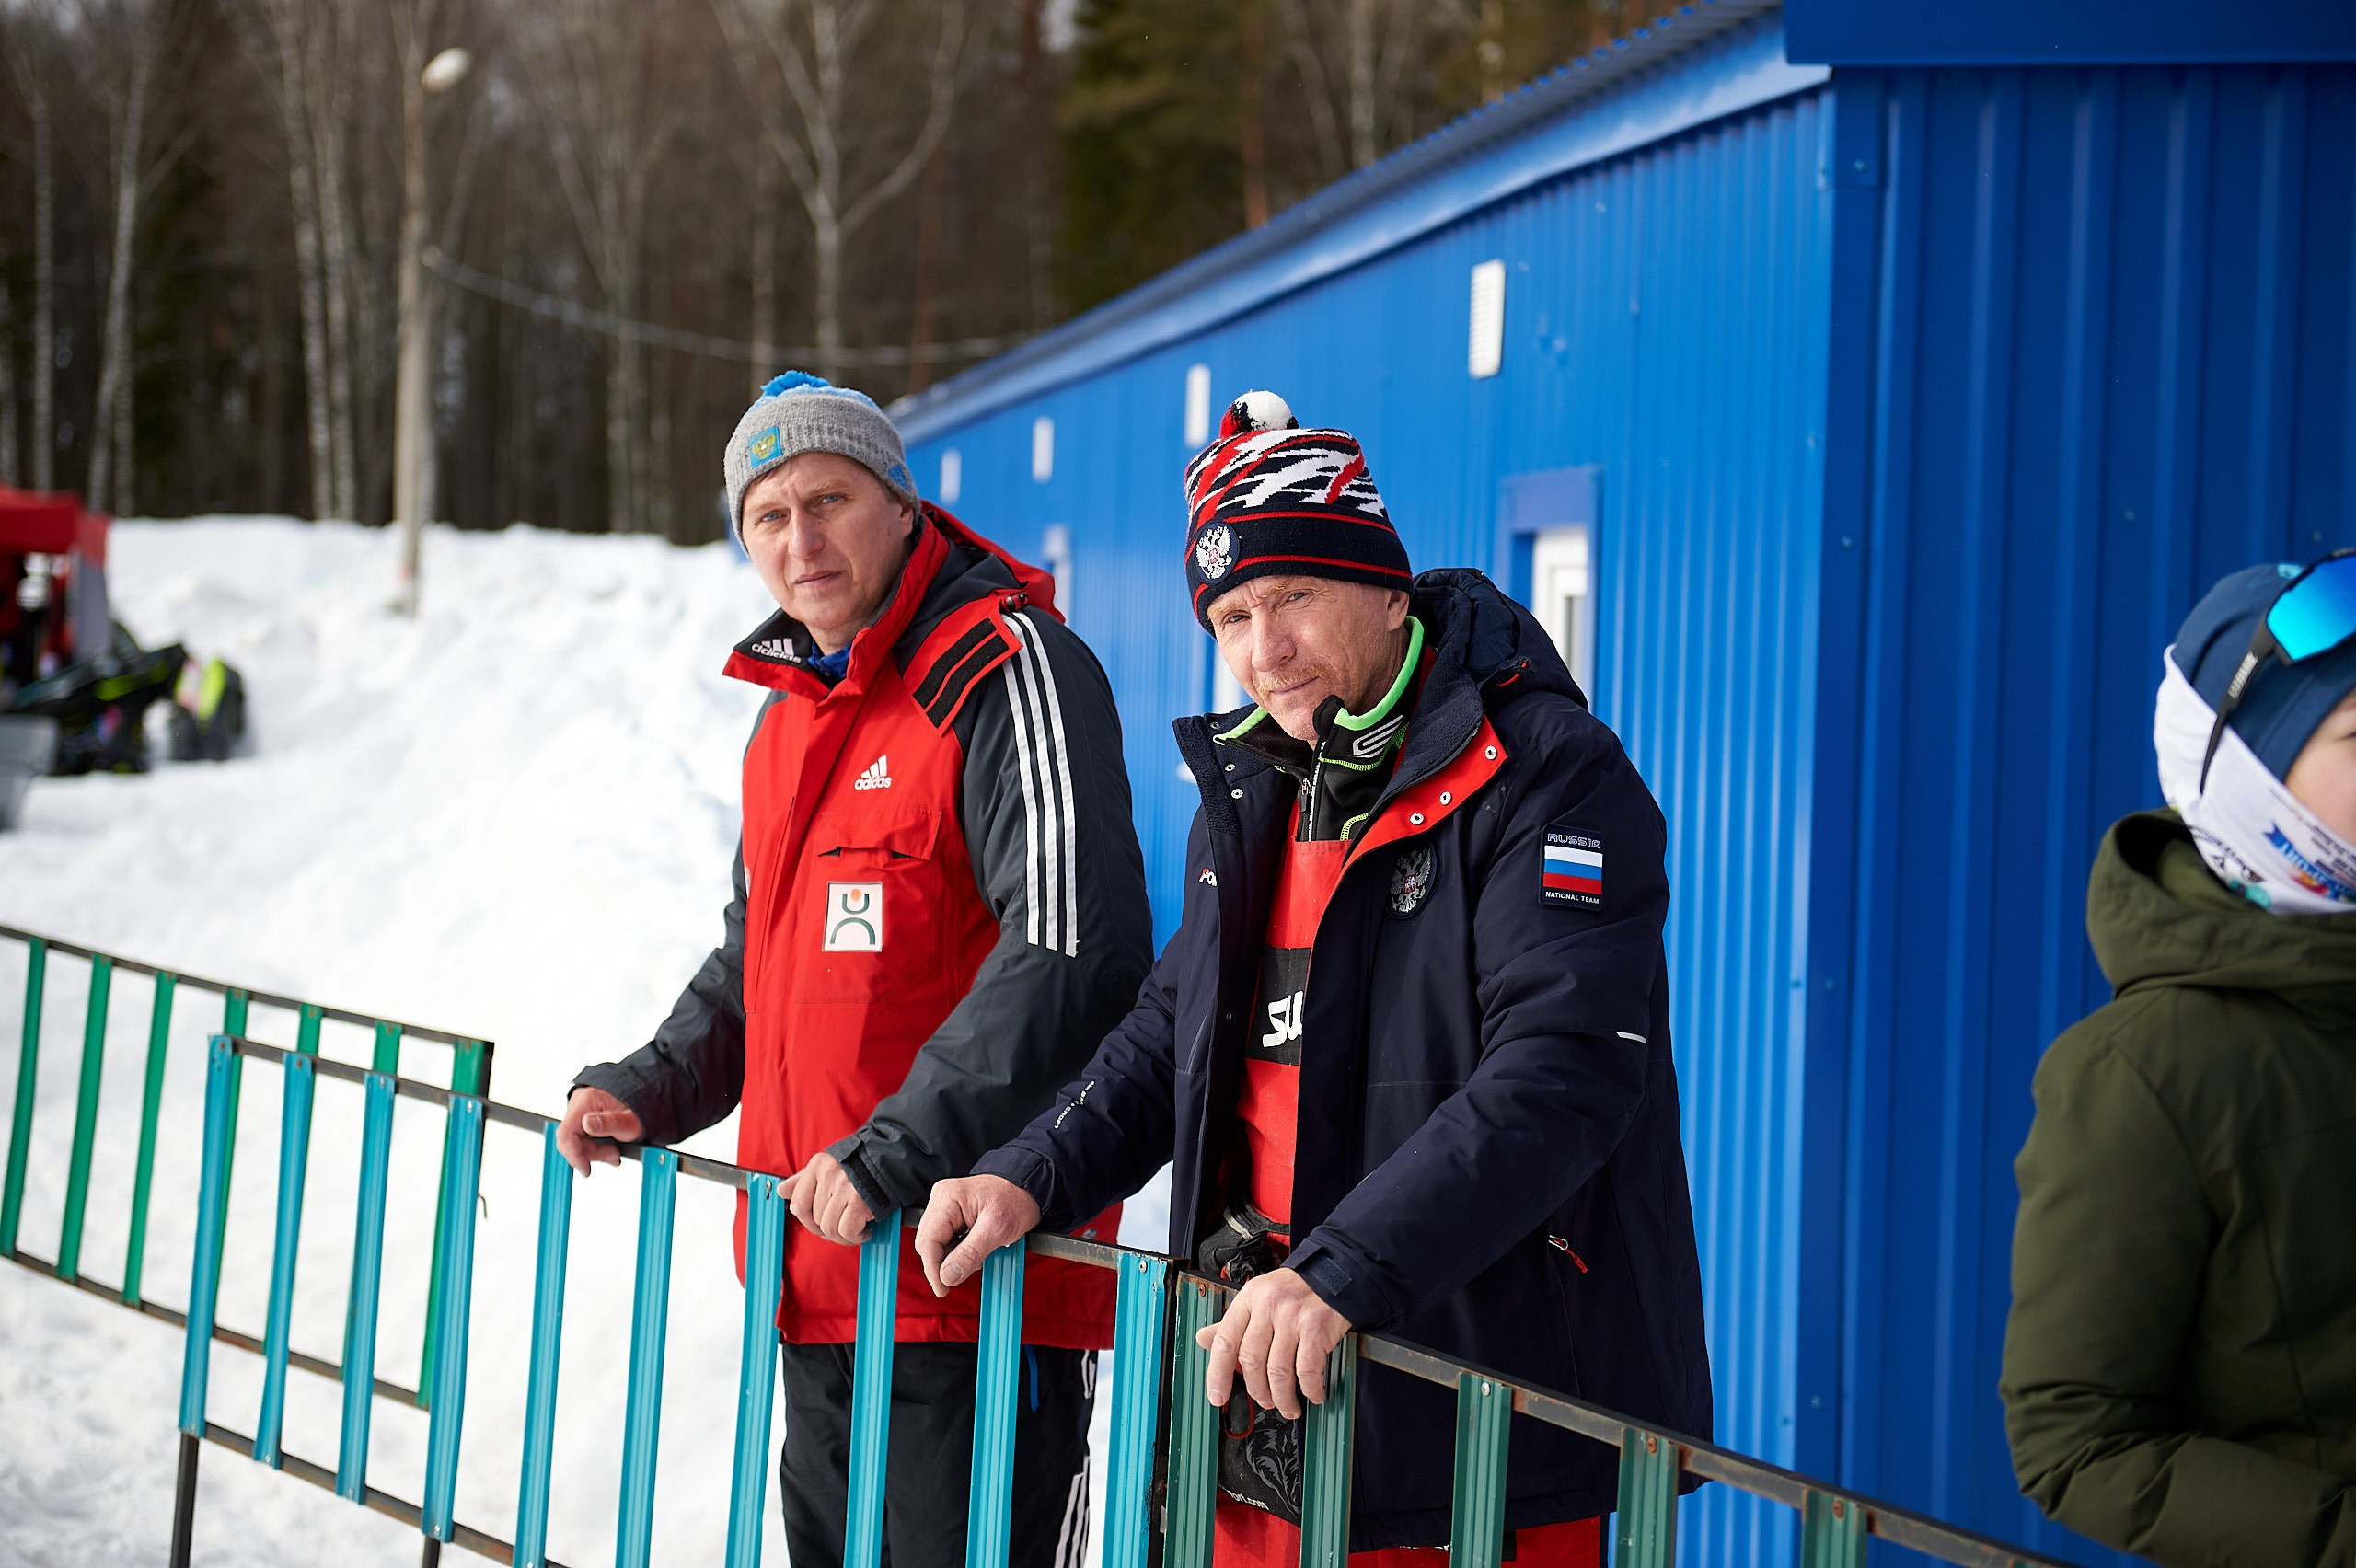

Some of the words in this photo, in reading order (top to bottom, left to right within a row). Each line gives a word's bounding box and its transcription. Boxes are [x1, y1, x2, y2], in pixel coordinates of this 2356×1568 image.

[751, 643, 801, 663] adidas
[854, 777, 892, 790] adidas
[1547, 833, 1601, 849] RUSSIA
[1545, 891, 1579, 902] NATIONAL
[1580, 895, 1600, 905] TEAM
